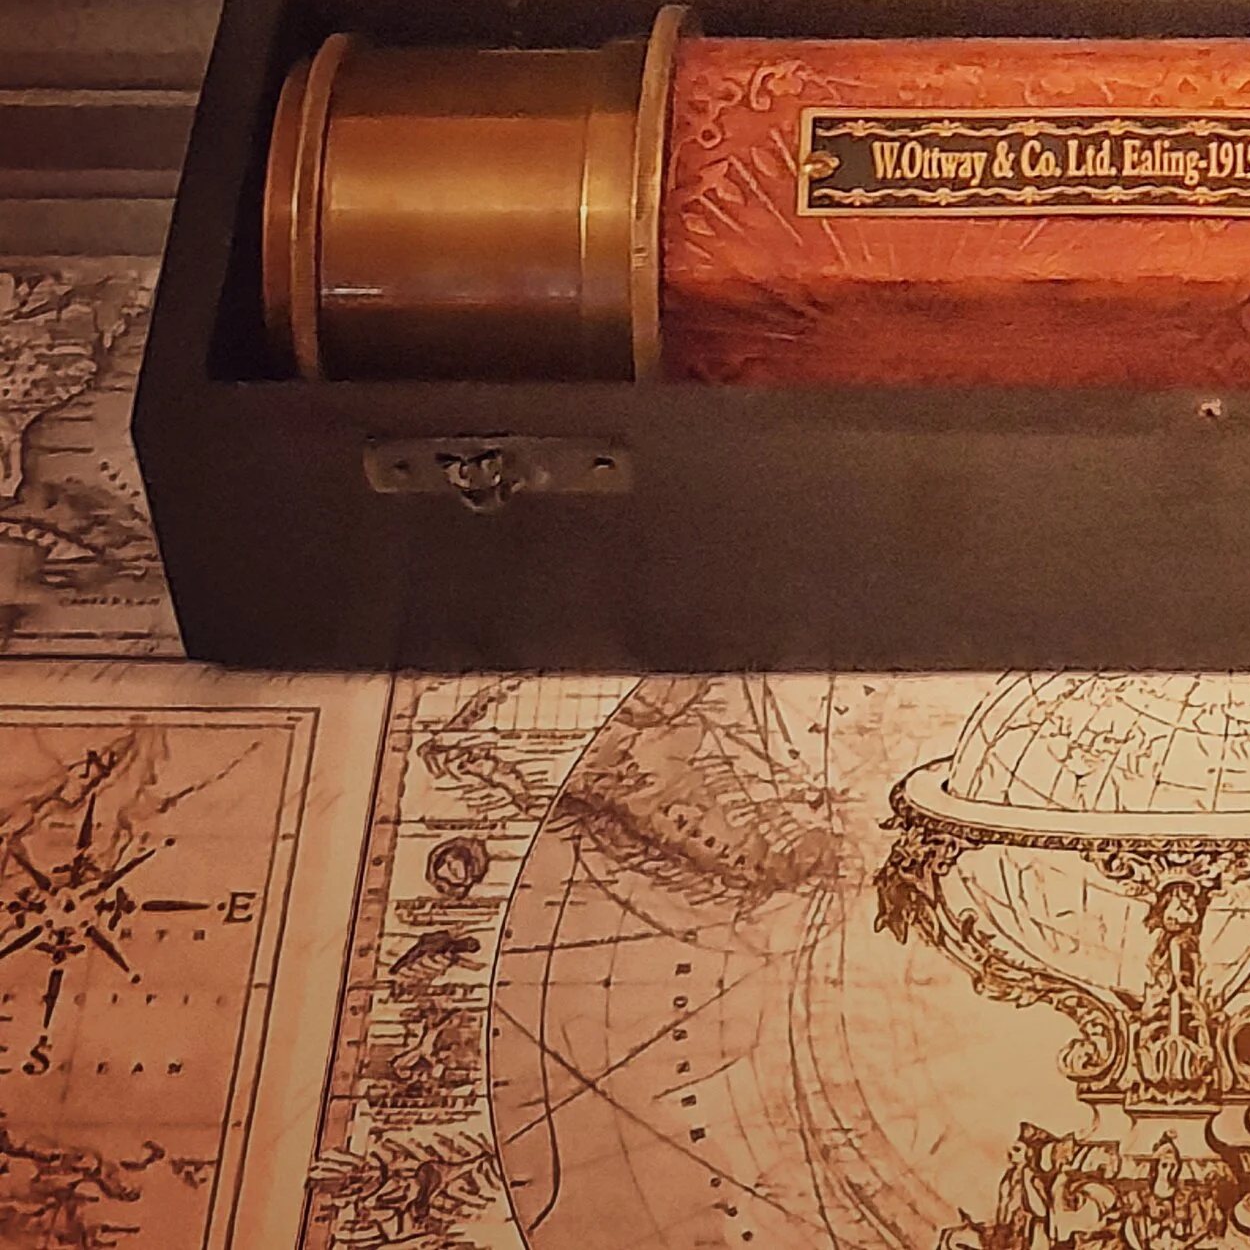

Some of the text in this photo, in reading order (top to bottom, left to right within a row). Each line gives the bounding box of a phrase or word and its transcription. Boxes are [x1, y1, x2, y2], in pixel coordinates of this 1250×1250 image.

[872, 139, 988, 187] W.Ottway
[992, 140, 1016, 179] &
[1020, 139, 1063, 178] Co.
[1066, 138, 1118, 177] Ltd.
[222, 891, 258, 924] E
